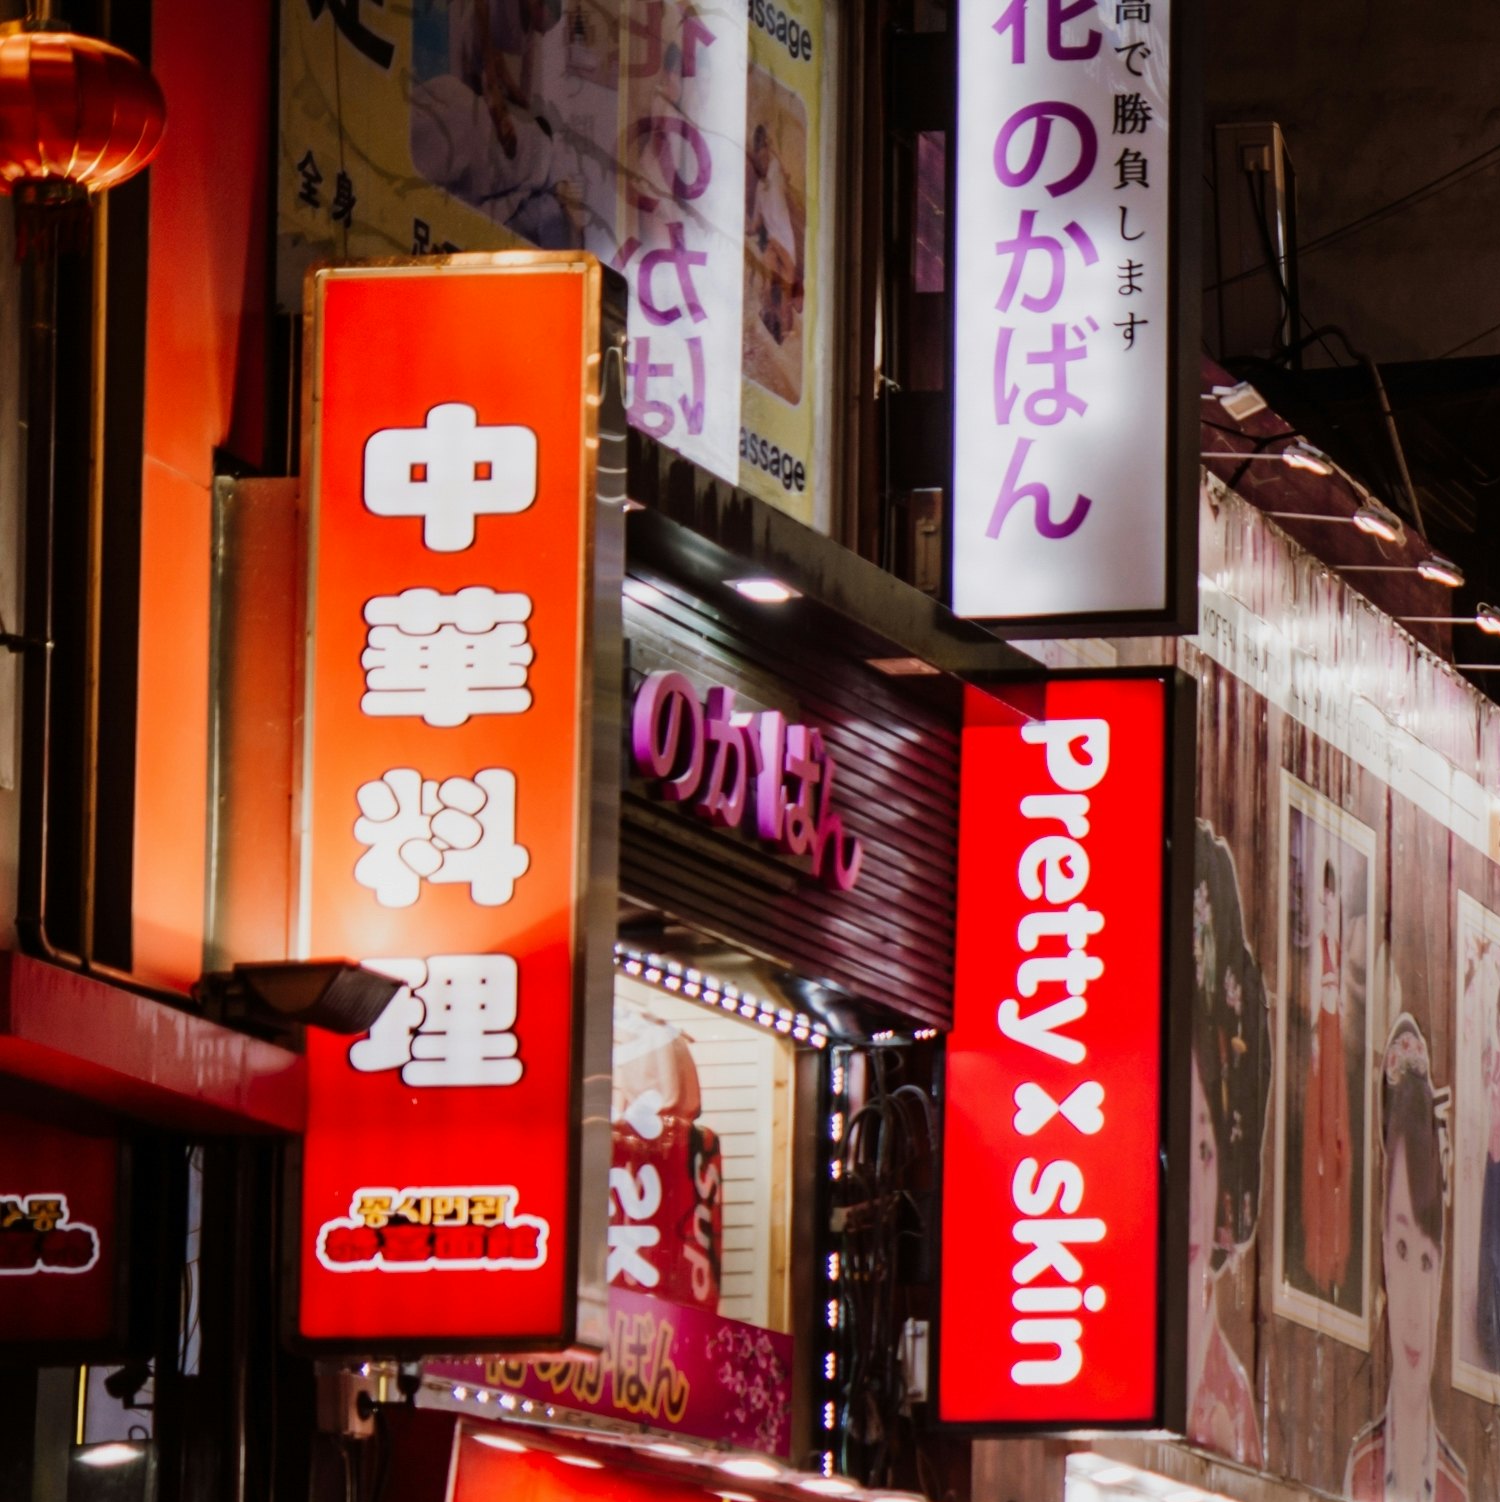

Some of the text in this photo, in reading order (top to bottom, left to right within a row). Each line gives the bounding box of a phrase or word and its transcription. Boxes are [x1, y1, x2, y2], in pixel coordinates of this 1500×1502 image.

[748, 0, 812, 61] assage
[739, 426, 806, 492] assage
[349, 403, 537, 1087] 中華料理
[996, 717, 1111, 1386] Pretty skin
